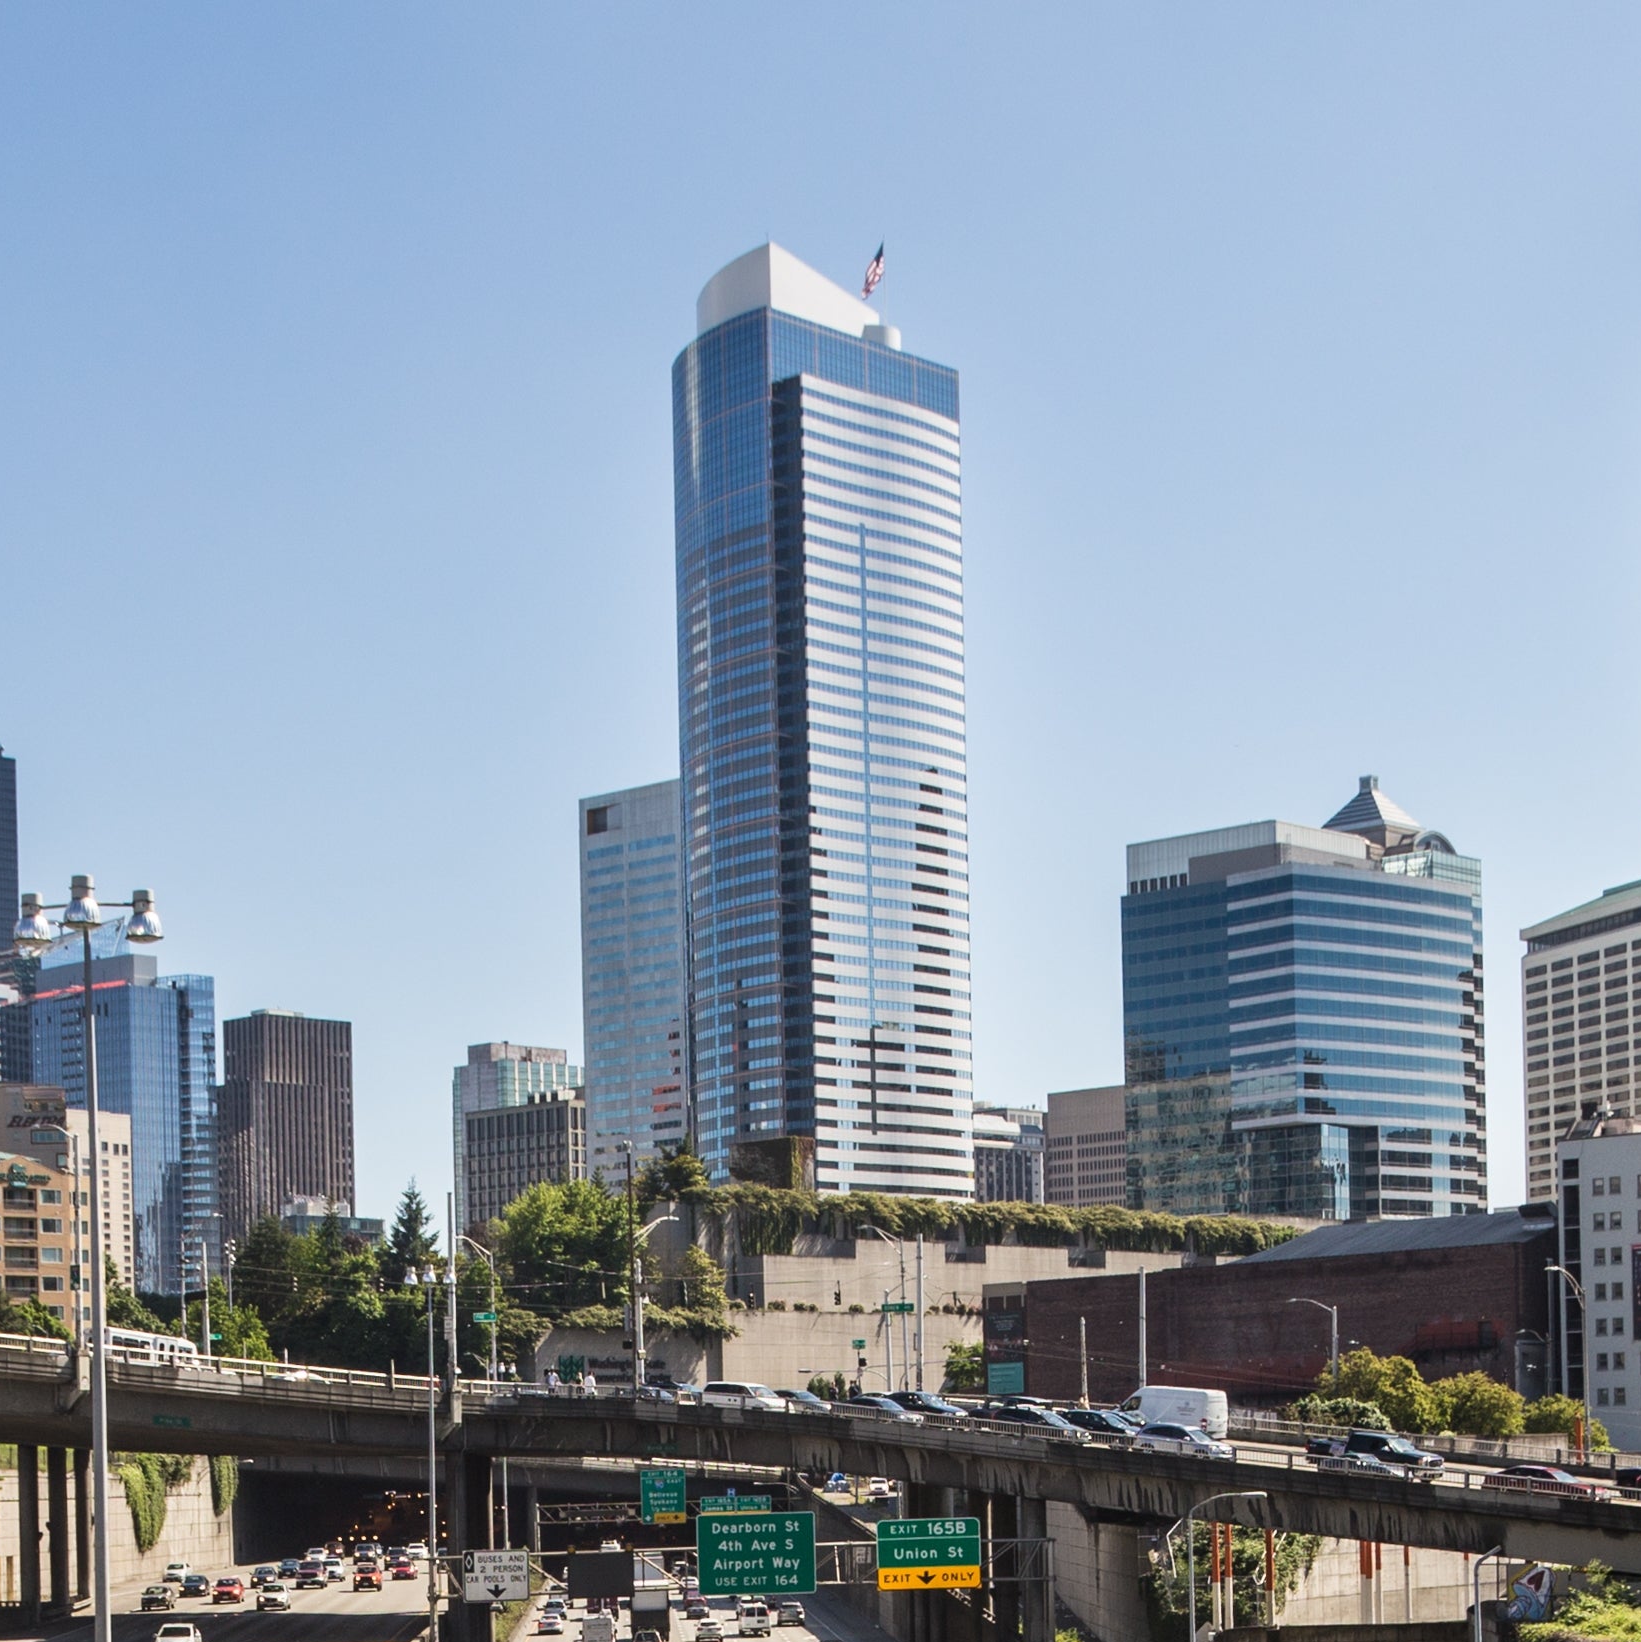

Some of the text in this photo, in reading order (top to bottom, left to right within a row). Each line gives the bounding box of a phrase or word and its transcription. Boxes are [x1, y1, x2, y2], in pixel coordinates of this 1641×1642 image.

[712, 1520, 799, 1534] Dearborn St
[890, 1522, 966, 1535] EXIT 165B
[718, 1539, 793, 1551] 4th Ave S
[894, 1546, 963, 1559] Union St
[478, 1555, 502, 1563] BUSES
[713, 1557, 800, 1571] Airport Way
[493, 1565, 523, 1573] PERSON
[484, 1575, 505, 1583] POOLS
[510, 1575, 526, 1583] ONLY
[715, 1575, 798, 1586] USE EXIT 164
[884, 1572, 974, 1583] EXIT ONLY
